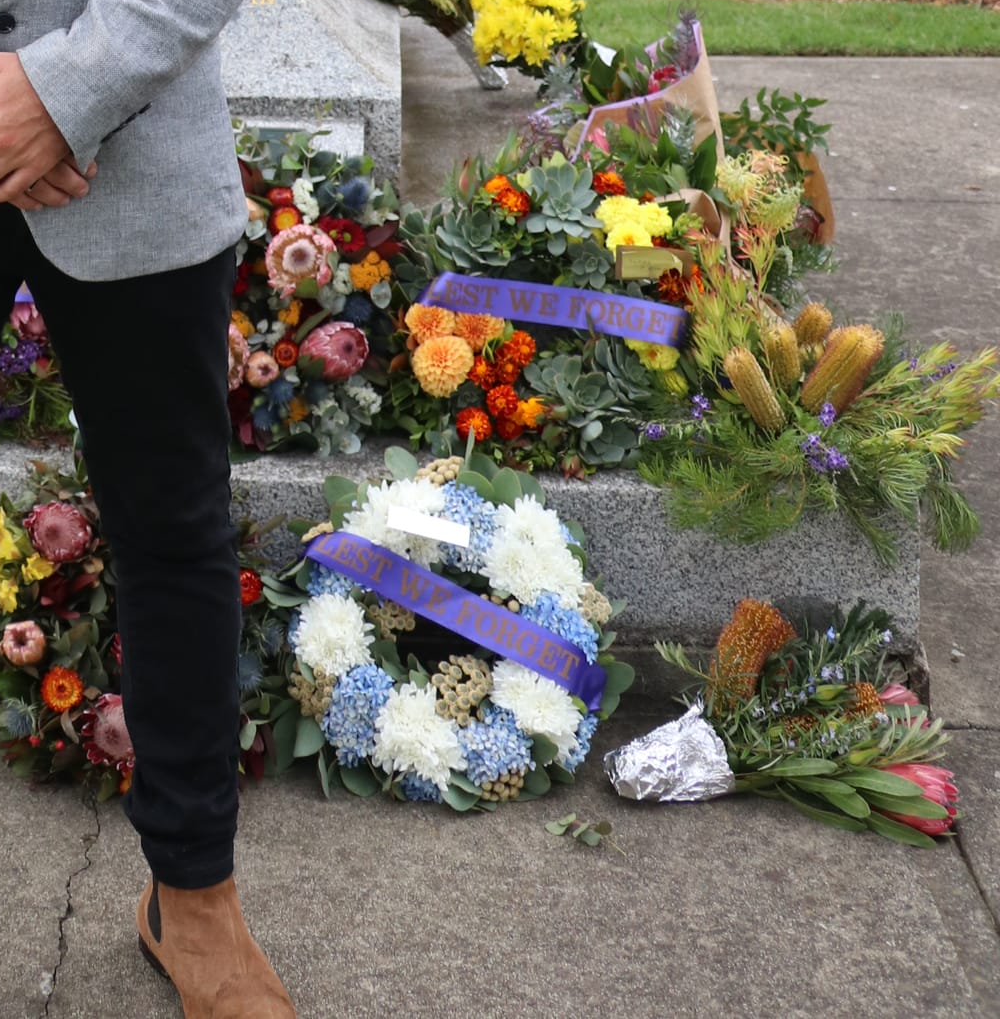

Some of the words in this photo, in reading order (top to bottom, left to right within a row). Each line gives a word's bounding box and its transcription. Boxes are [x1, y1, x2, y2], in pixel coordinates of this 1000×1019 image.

[427, 279, 499, 308] LEST
[509, 288, 560, 317] WE
[568, 296, 686, 342] FORGET
[313, 534, 393, 581] LEST
[400, 562, 452, 616] WE
[455, 599, 581, 682] FORGET
